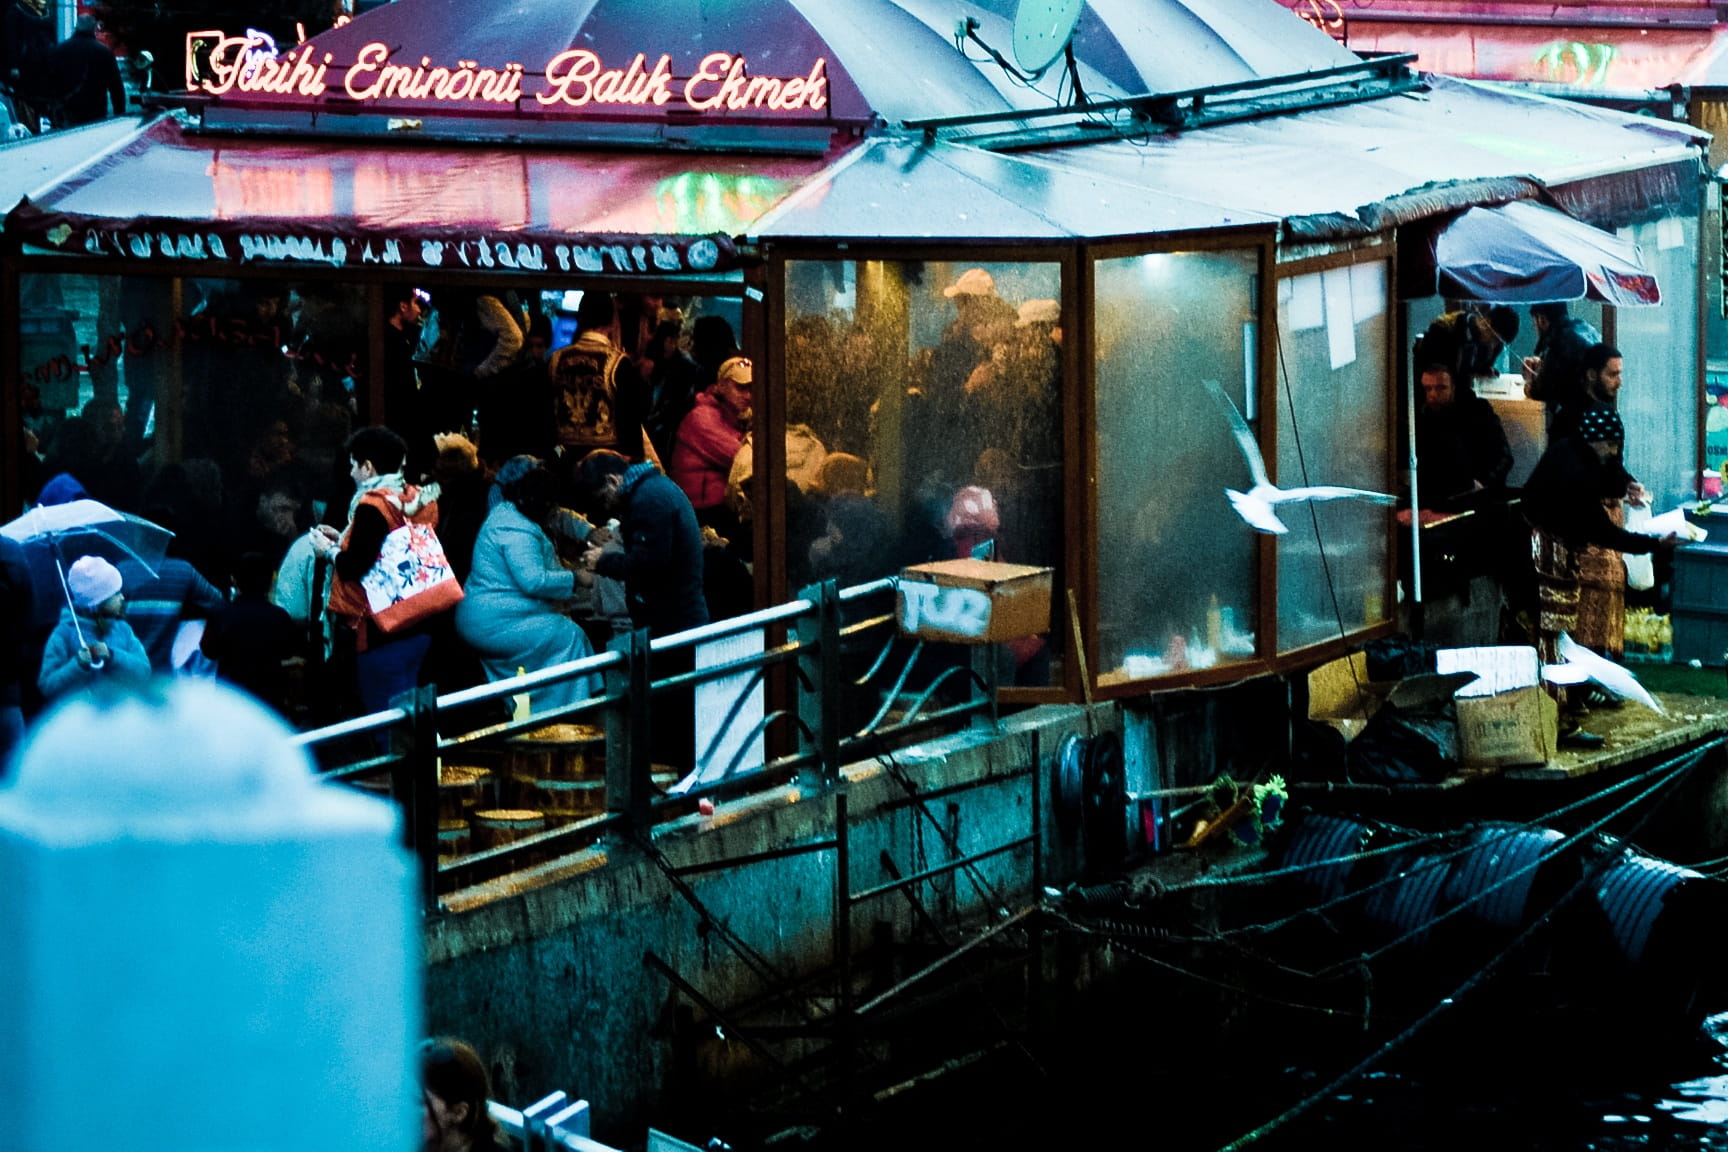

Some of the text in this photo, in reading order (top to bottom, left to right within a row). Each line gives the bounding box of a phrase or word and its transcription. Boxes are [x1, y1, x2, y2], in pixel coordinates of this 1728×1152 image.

[203, 37, 828, 111] Tarihi Eminönü Balık Ekmek
